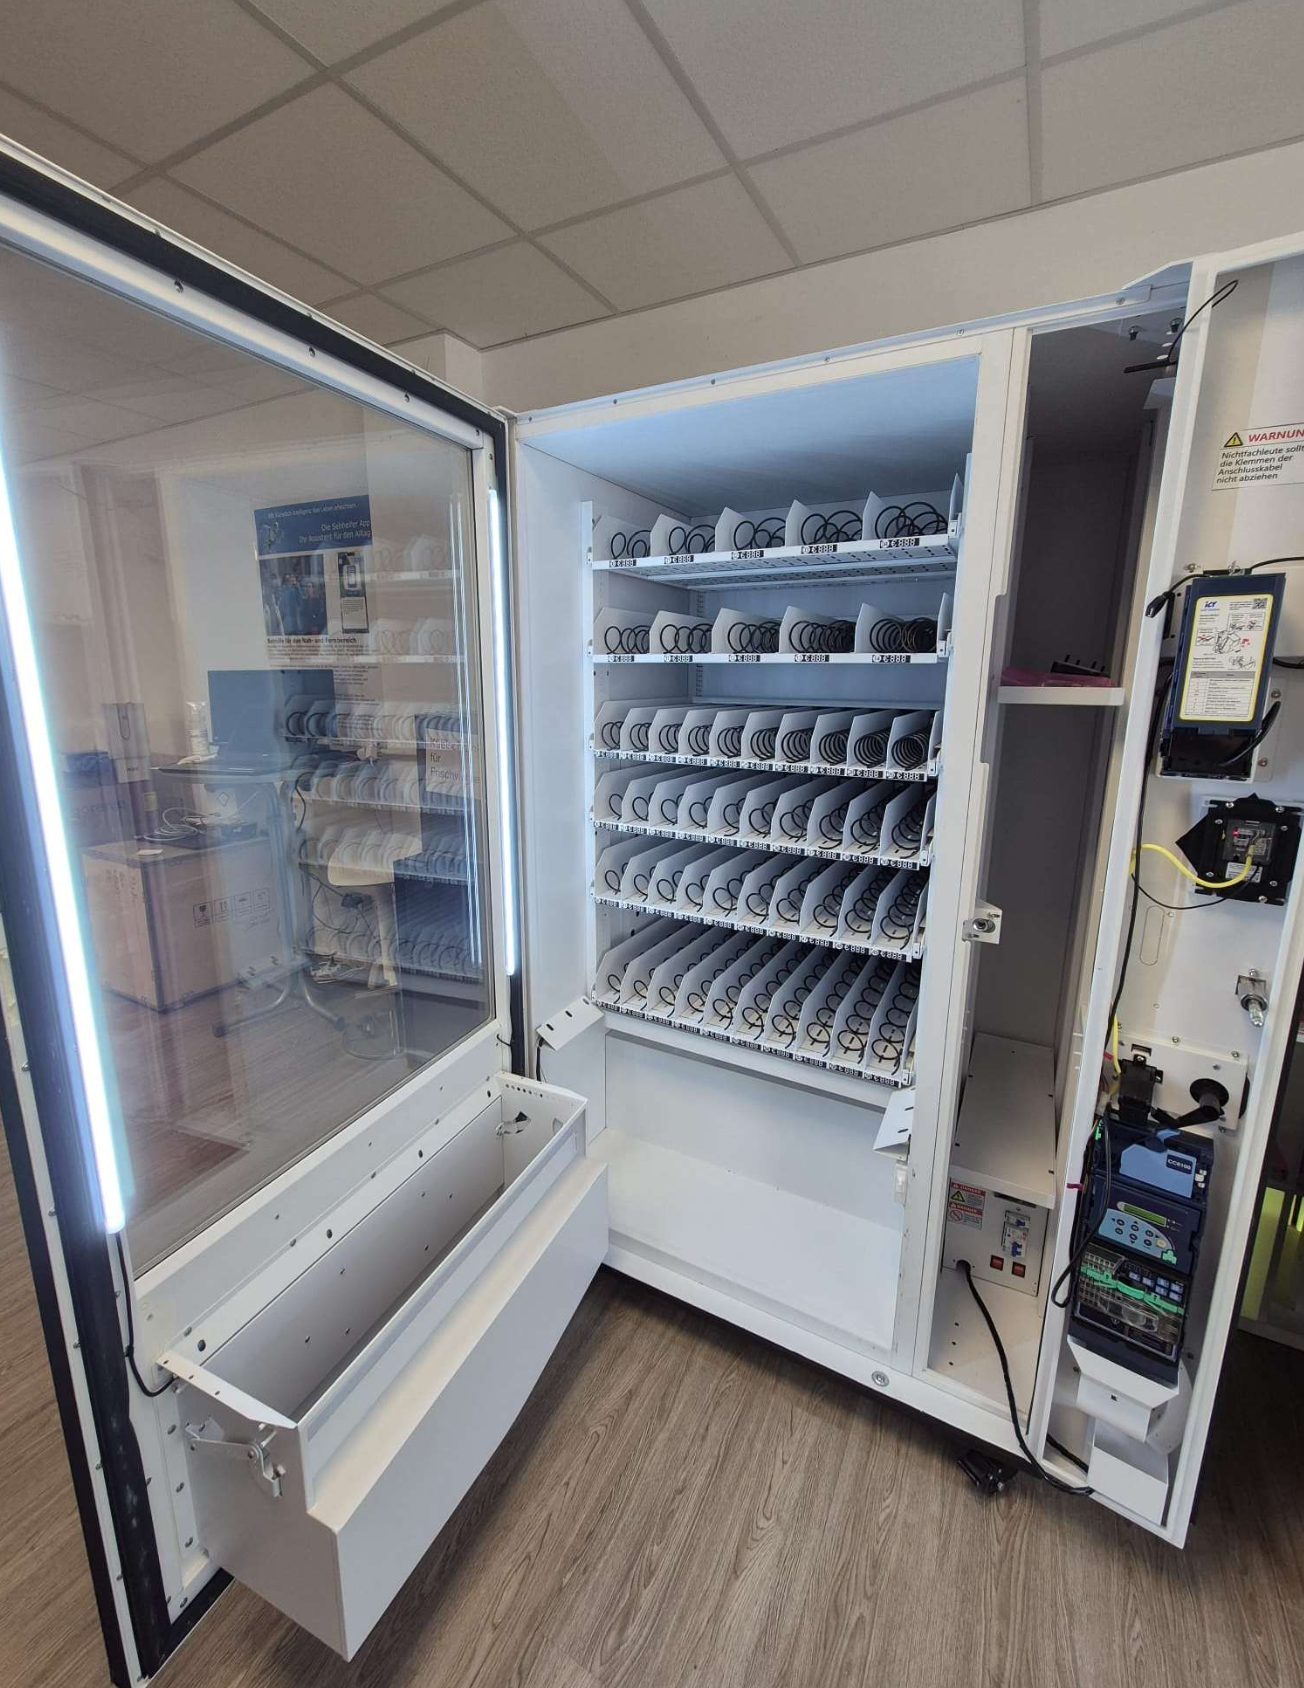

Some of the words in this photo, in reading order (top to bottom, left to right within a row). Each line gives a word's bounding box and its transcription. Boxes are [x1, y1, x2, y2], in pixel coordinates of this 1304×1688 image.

[1221, 448, 1284, 460] Nichtfachleute
[1234, 457, 1275, 466] Klemmen
[1278, 454, 1294, 462] der
[1218, 464, 1283, 476] Anschlusskabel
[1216, 476, 1237, 484] nicht
[1239, 473, 1278, 482] abziehen
